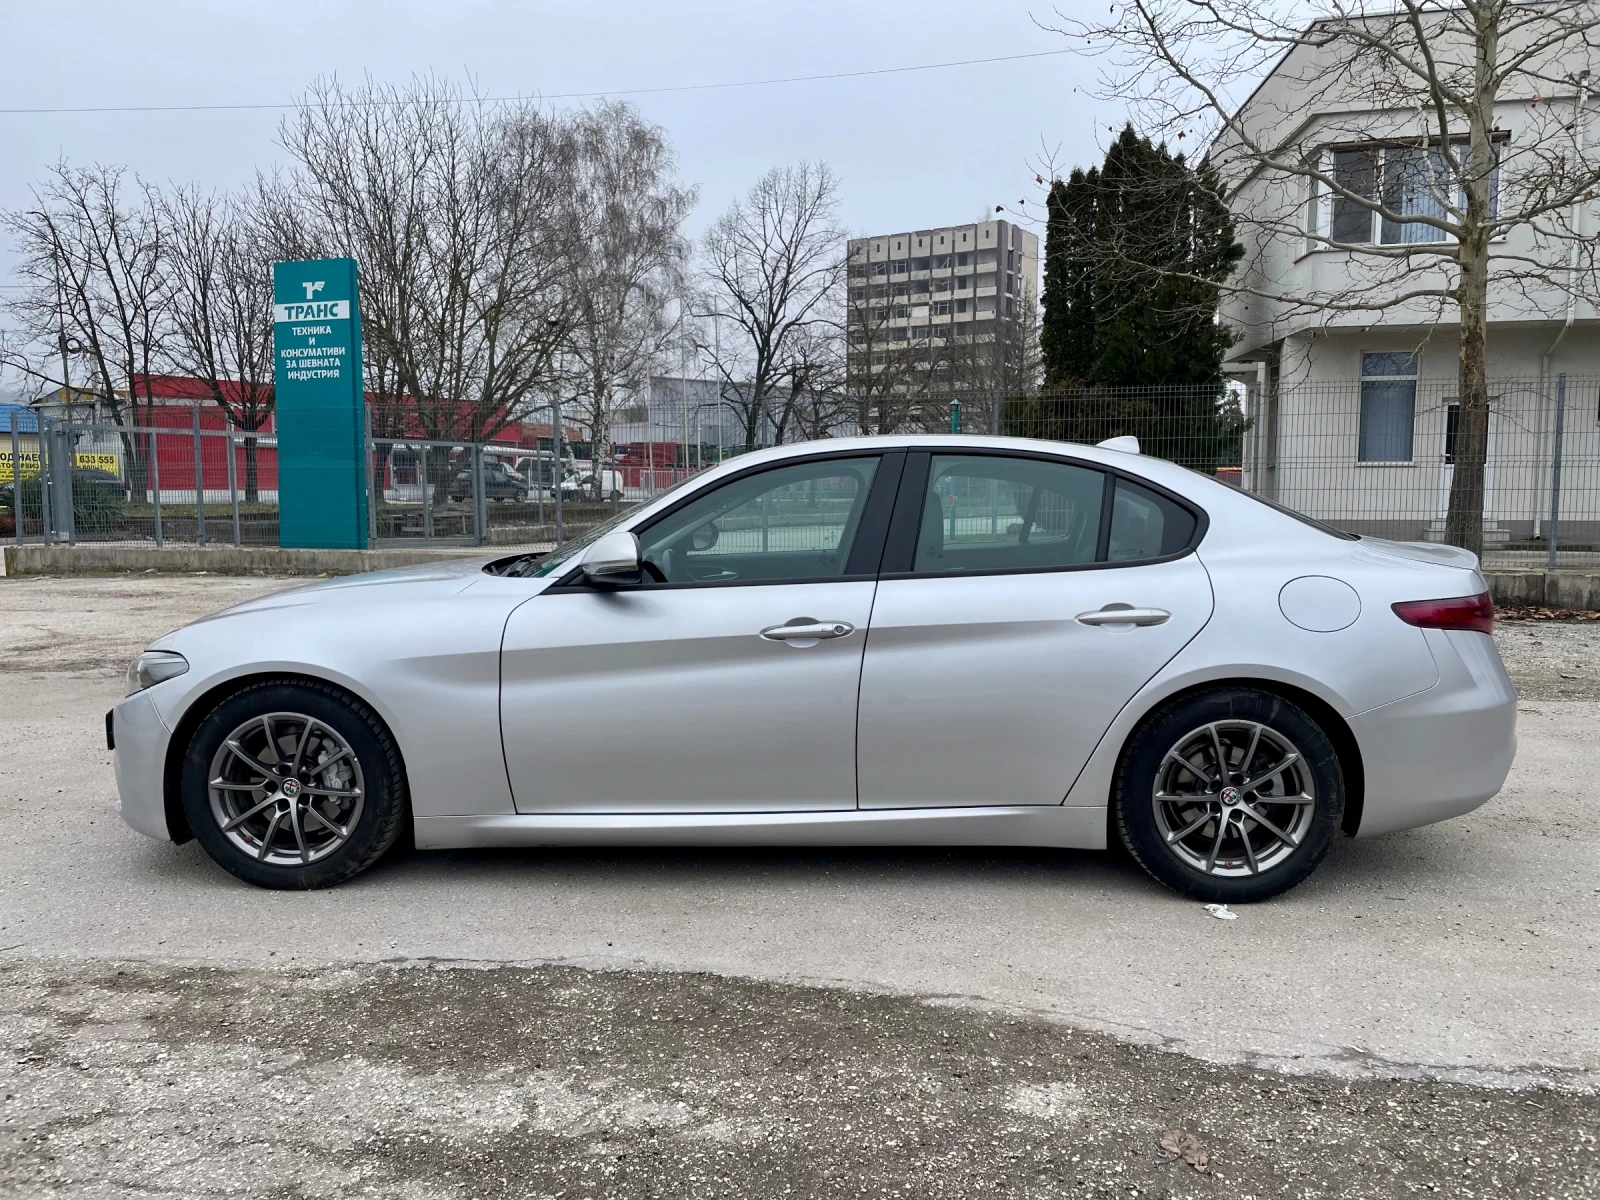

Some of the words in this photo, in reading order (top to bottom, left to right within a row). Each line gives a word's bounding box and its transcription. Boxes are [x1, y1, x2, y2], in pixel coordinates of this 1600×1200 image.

[284, 303, 339, 320] ТРАНС
[291, 325, 332, 336] ТЕХНИКА
[308, 337, 316, 346] И
[281, 347, 346, 358] КОНСУМАТИВИ
[285, 360, 297, 369] ЗА
[298, 358, 341, 368] ШЕВНАТА
[287, 369, 340, 381] ИНДУСТРИЯ
[0, 453, 14, 462] ОД
[18, 453, 41, 462] НАЕ
[79, 455, 96, 464] 633
[98, 455, 115, 464] 555
